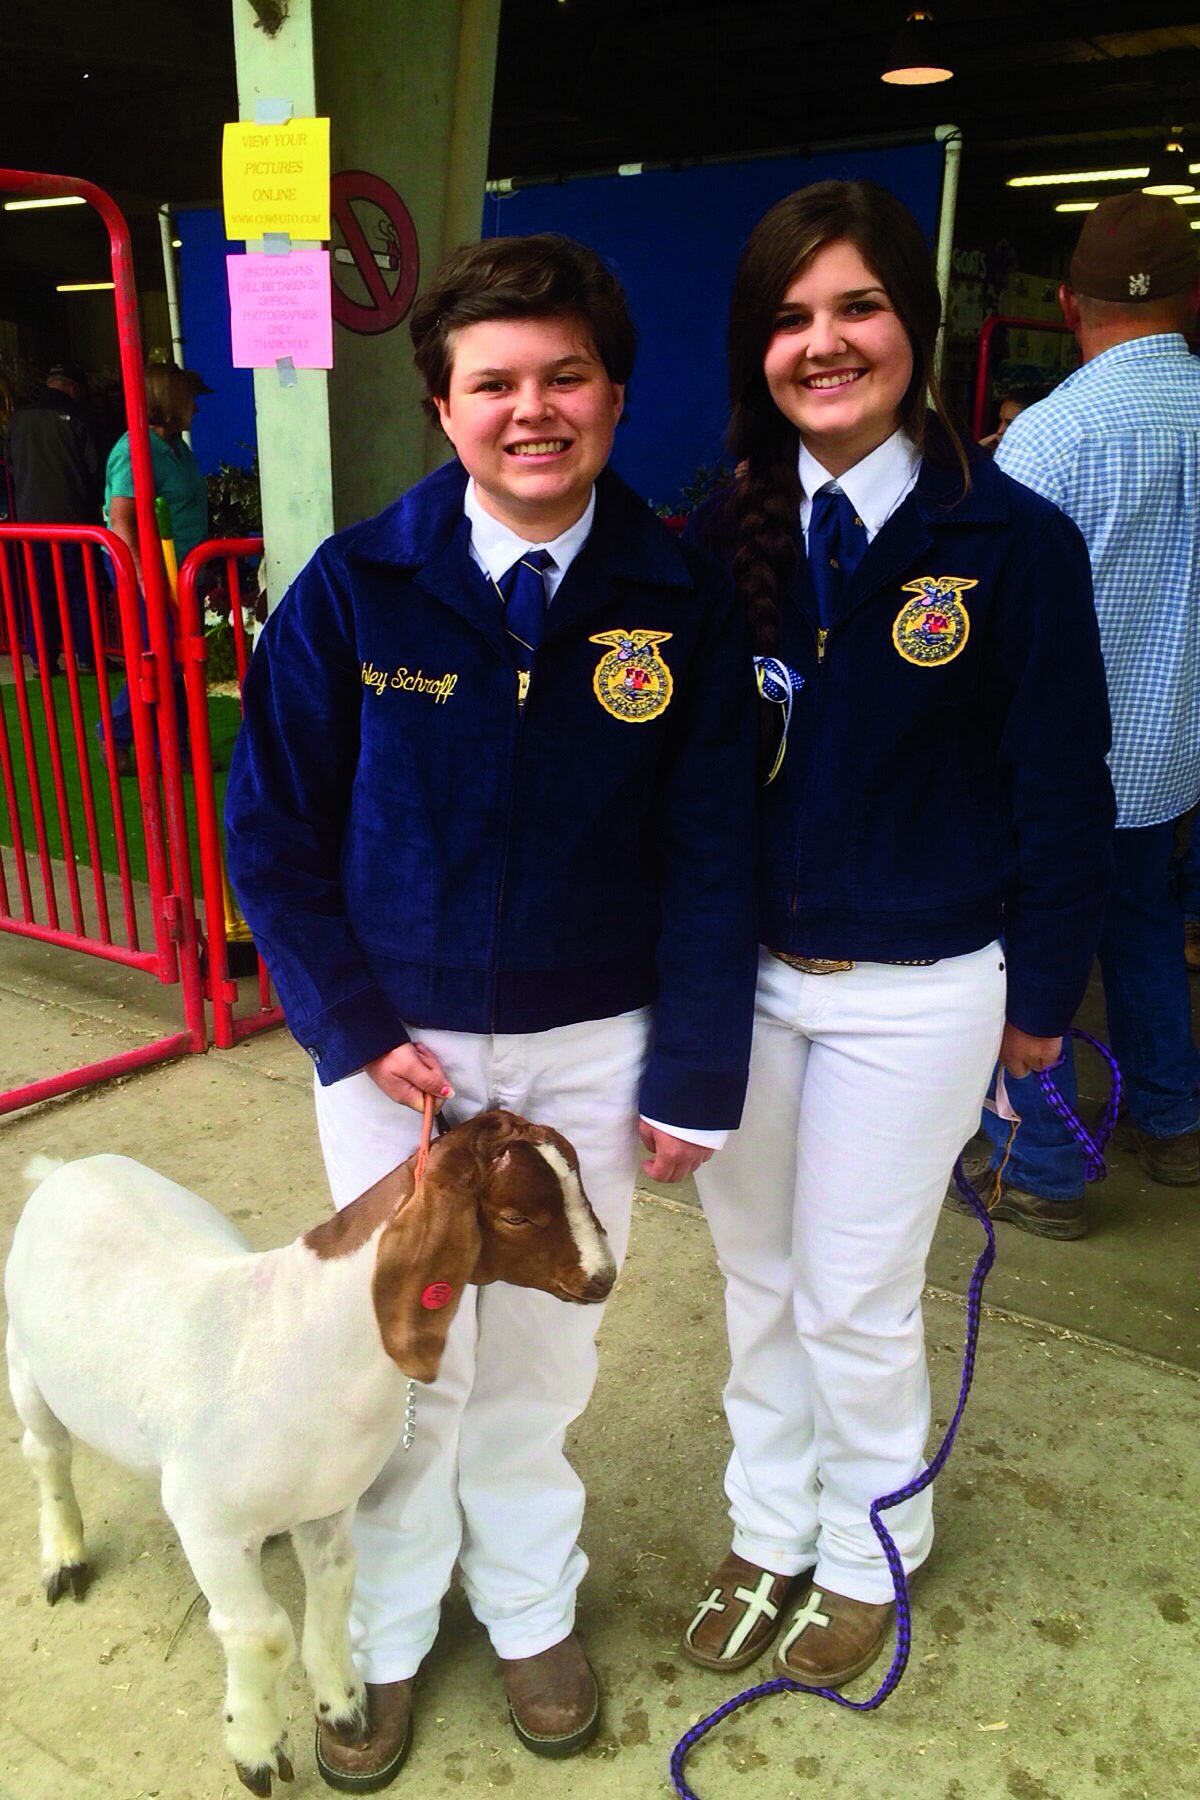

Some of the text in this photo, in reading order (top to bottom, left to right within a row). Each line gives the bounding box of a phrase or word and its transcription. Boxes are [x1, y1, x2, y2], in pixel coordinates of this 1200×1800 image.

[242, 133, 308, 148] VIEW YOUR
[244, 160, 304, 175] PICTURES
[252, 188, 297, 202] ONLINE
[244, 264, 314, 278] PHOTOGRAPHS
[238, 279, 321, 292] WILL BE TAKEN BY
[258, 295, 300, 306] OFFICIAL
[243, 310, 318, 321] PHOTOGRAPHER
[267, 324, 293, 335] ONLY
[254, 339, 285, 350] THANK
[925, 613, 949, 630] FFA
[625, 667, 652, 685] FFA
[390, 667, 459, 704] Schroff
